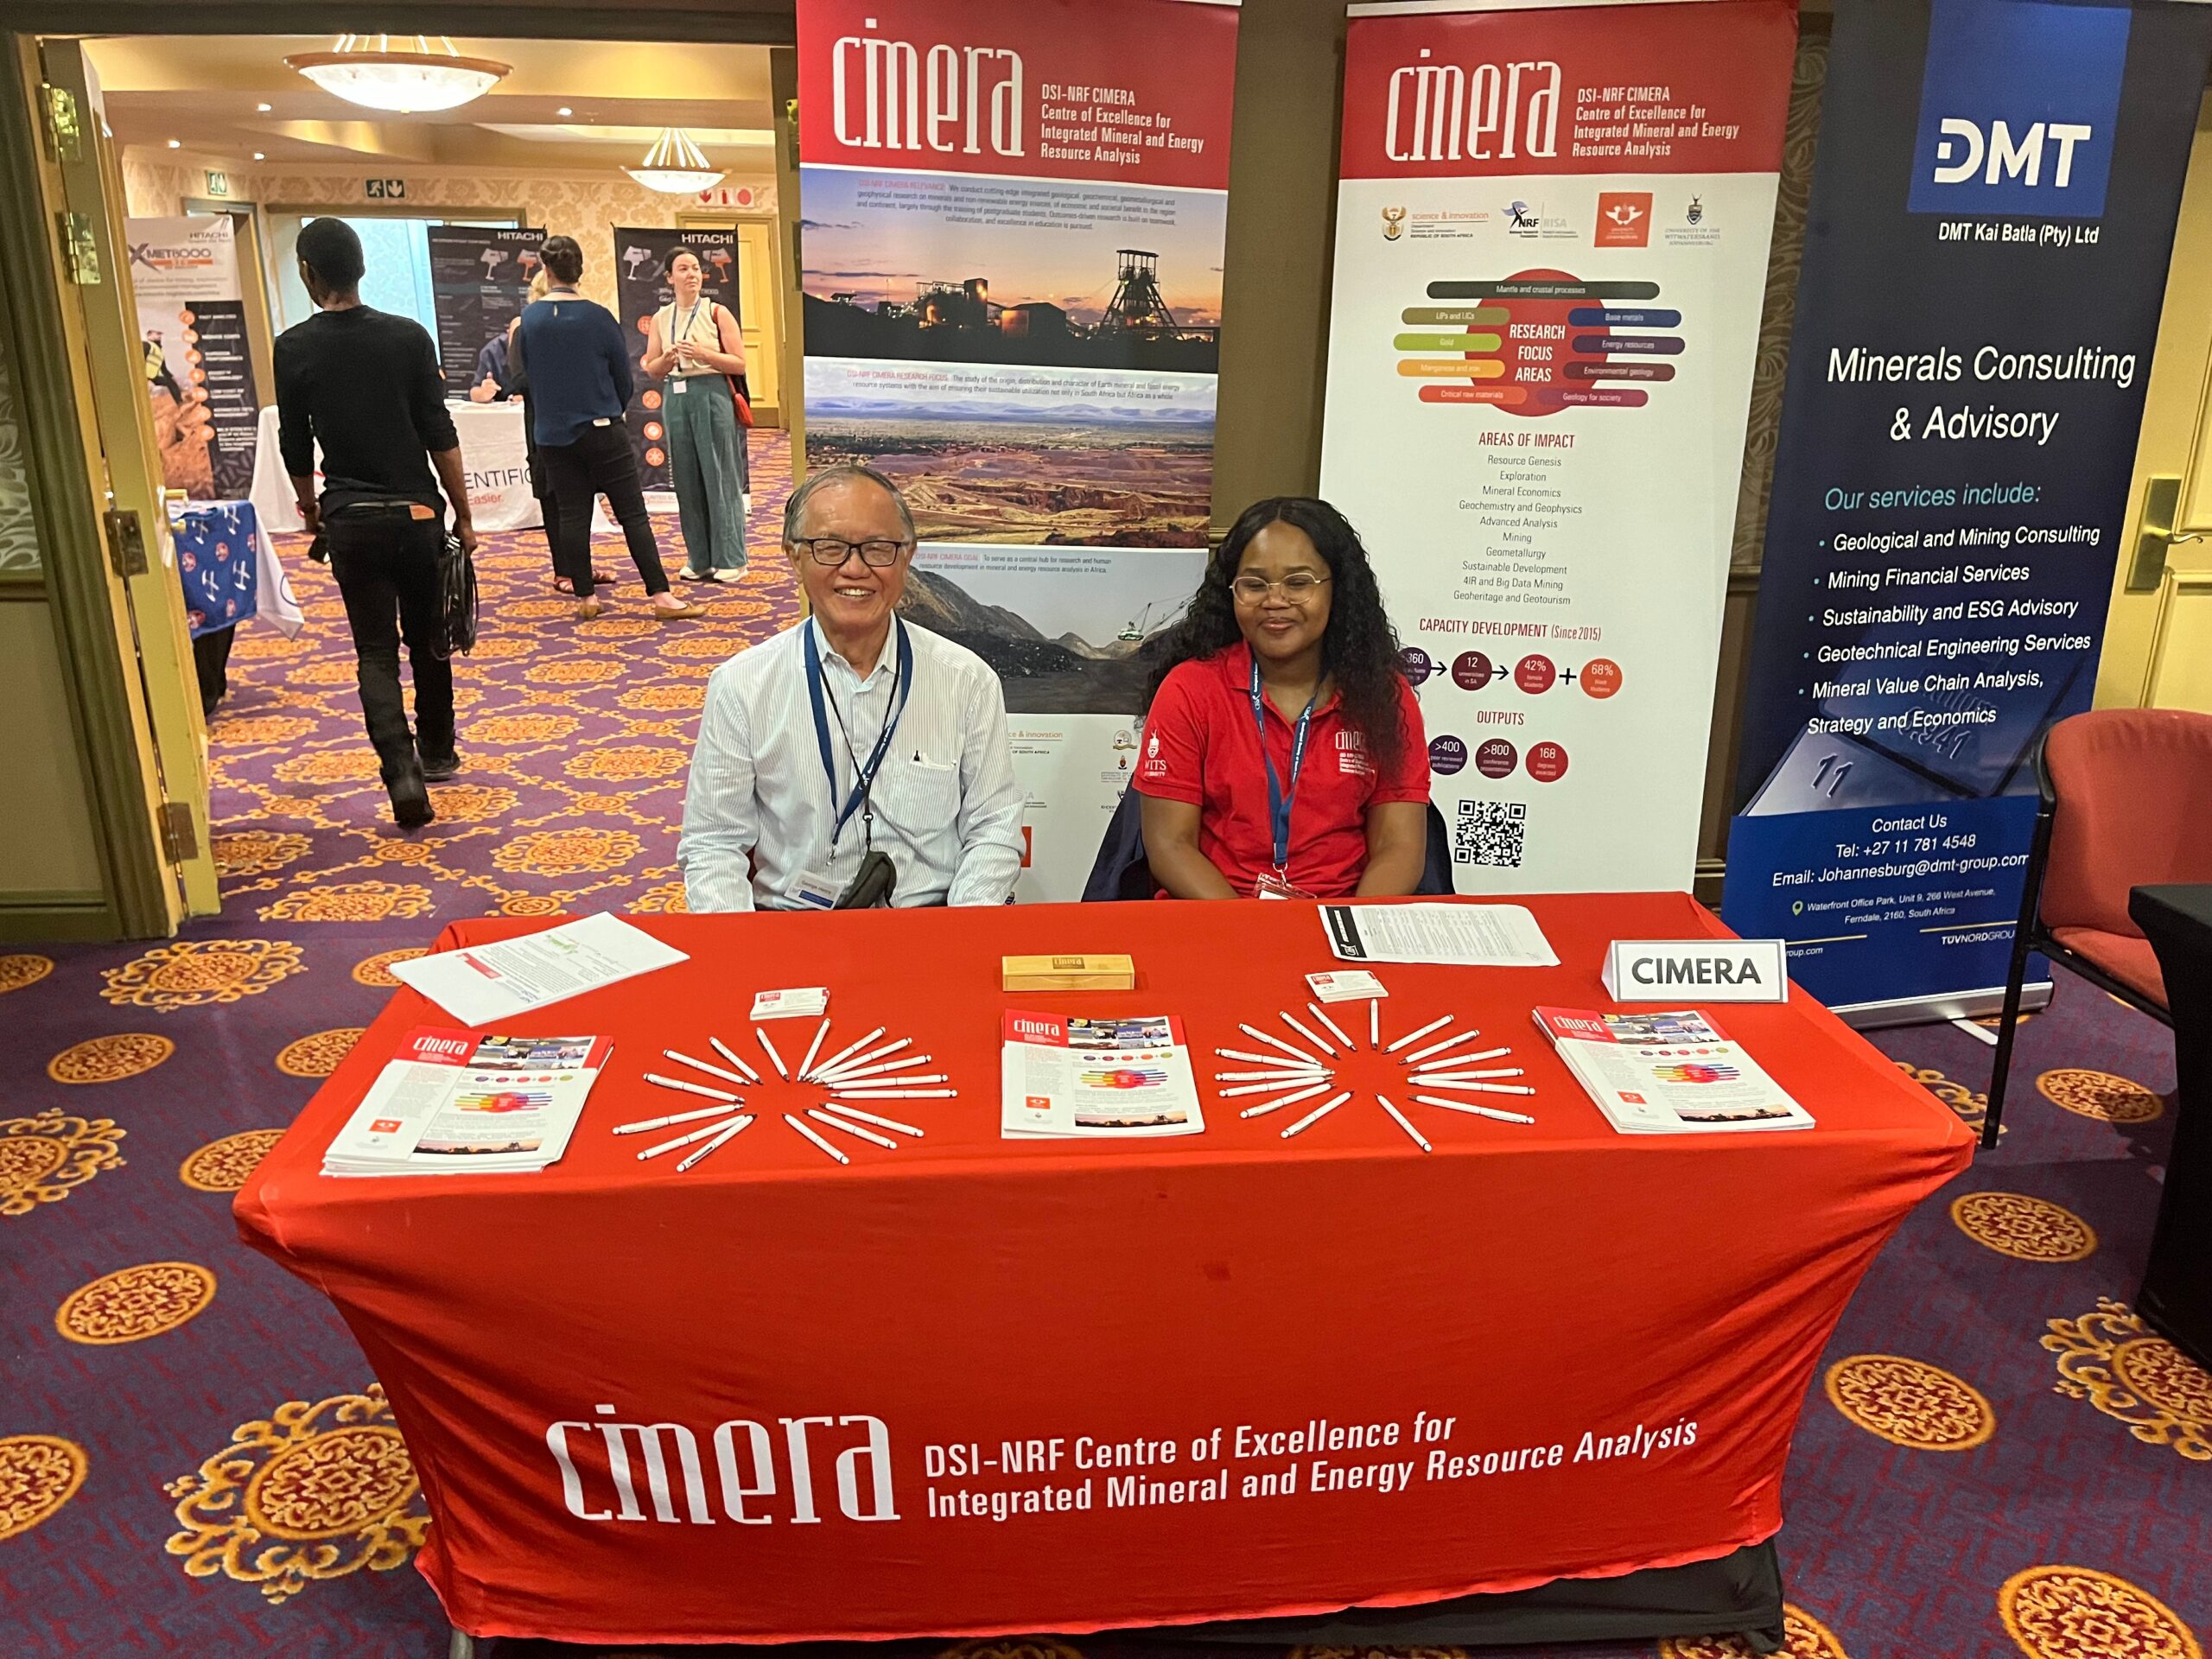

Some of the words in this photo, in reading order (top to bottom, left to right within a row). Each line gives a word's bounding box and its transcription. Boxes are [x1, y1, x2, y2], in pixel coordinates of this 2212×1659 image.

[832, 18, 1025, 156] cimera
[1042, 84, 1090, 102] DSI-NRF
[1092, 88, 1135, 105] CIMERA
[1578, 87, 1625, 103] DSI-NRF
[1627, 87, 1669, 101] CIMERA
[1385, 48, 1561, 161] cimera
[1041, 104, 1077, 120] Centre
[1081, 107, 1092, 122] of
[1096, 108, 1152, 127] Excellence
[1156, 112, 1171, 128] for
[1576, 107, 1610, 121] Centre
[1615, 106, 1625, 120] of
[1629, 105, 1686, 120] Excellence
[1690, 105, 1706, 118] for
[1041, 124, 1097, 143] Integrated
[1102, 127, 1141, 145] Mineral
[1146, 133, 1164, 147] and
[1168, 133, 1204, 153] Energy
[1573, 124, 1629, 141] Integrated
[1632, 124, 1675, 138] Mineral
[1678, 124, 1699, 137] and
[1702, 124, 1739, 139] Energy
[1041, 143, 1090, 160] Resource
[1094, 146, 1140, 166] Analysis
[1573, 143, 1621, 157] Resource
[1624, 142, 1671, 158] Analysis
[1934, 118, 2091, 188] DMT
[1519, 219, 1539, 227] NRF
[498, 232, 543, 241] HITACHI
[682, 233, 734, 244] HITACHI
[1939, 223, 1973, 240] DMT
[1974, 223, 1999, 241] Kai
[2002, 224, 2036, 242] Batla
[2039, 225, 2071, 247] (Pty)
[2075, 226, 2100, 244] Ltd
[1497, 285, 1518, 294] Mantle
[1510, 325, 1566, 340] RESEARCH
[1602, 340, 1622, 349] Energy
[1518, 346, 1553, 360] FOCUS
[1516, 368, 1551, 382] AREAS
[1584, 367, 1628, 376] Environmental
[1630, 368, 1654, 378] geology
[1827, 347, 1962, 382] Minerals
[1974, 346, 2135, 389] Consulting
[1563, 393, 1587, 402] Geology
[1599, 394, 1621, 403] society
[1891, 407, 1911, 441] &
[1923, 405, 2058, 445] Advisory
[1478, 432, 1514, 446] AREAS
[1517, 433, 1531, 447] OF
[1535, 434, 1575, 448] IMPACT
[1488, 455, 1526, 466] Resource
[1529, 456, 1561, 467] Genesis
[1500, 471, 1546, 481] Exploration
[1483, 486, 1515, 496] Mineral
[1517, 487, 1561, 497] Economics
[1825, 487, 1864, 510] Our
[1869, 485, 1955, 509] services
[1963, 481, 2041, 505] include:
[1459, 500, 1515, 512] Geochemistry
[1517, 503, 1533, 512] and
[1535, 504, 1582, 514] Geophysics
[1480, 517, 1520, 527] Advanced
[1522, 518, 1557, 529] Analysis
[1503, 533, 1532, 543] Mining
[1834, 531, 1919, 553] Geological
[1923, 530, 1955, 548] and
[1960, 528, 2011, 548] Mining
[2015, 525, 2101, 546] Consulting
[1486, 547, 1546, 559] Geometallurgy
[1462, 562, 1510, 572] Sustainable
[1513, 563, 1567, 575] Development
[1464, 576, 1477, 585] 4IR
[1497, 579, 1510, 588] Big
[1512, 579, 1531, 588] Data
[1535, 580, 1563, 591] Mining
[1828, 571, 1879, 591] Mining
[1885, 567, 1958, 587] Financial
[1962, 563, 2030, 582] Services
[1454, 591, 1503, 602] Geoheritage
[1505, 594, 1521, 602] and
[1523, 594, 1571, 605] Geotourism
[1822, 605, 1929, 626] Sustainability
[1933, 603, 1963, 620] and
[1967, 601, 2004, 618] ESG
[2007, 599, 2078, 619] Advisory
[1420, 619, 1469, 633] CAPACITY
[1472, 621, 1548, 638] DEVELOPMENT
[1551, 624, 1577, 639] (Since
[1578, 626, 1601, 641] 2015)
[1817, 641, 1922, 663] Geotechnical
[1927, 637, 2019, 659] Engineering
[2024, 633, 2091, 652] Services
[1467, 657, 1478, 668] 12
[1524, 660, 1547, 672] 42%
[1592, 664, 1613, 676] 68%
[1813, 679, 1870, 699] Mineral
[1876, 677, 1919, 695] Value
[1924, 674, 1969, 692] Chain
[1974, 671, 2044, 690] Analysis,
[1478, 710, 1524, 726] OUTPUTS
[1808, 714, 1873, 734] Strategy
[1877, 711, 1907, 730] and
[1912, 709, 1997, 728] Economics
[1434, 741, 1459, 753] >400
[1484, 745, 1509, 756] >800
[1540, 747, 1555, 759] 168
[1872, 817, 1925, 833] Contact
[1929, 815, 1948, 830] Us
[1836, 843, 1859, 858] Tel:
[1863, 842, 1890, 856] +27
[1894, 840, 1908, 854] 11
[1914, 838, 1937, 852] 781
[1942, 834, 1976, 850] 4548
[1772, 870, 1815, 887] Email:
[1808, 900, 1849, 912] Waterfront
[1851, 898, 1874, 909] Office
[1899, 894, 1916, 904] Unit
[1943, 890, 1963, 899] West
[1909, 908, 1932, 919] South
[1934, 906, 1955, 916] Africa
[1631, 957, 1762, 984] CIMERA
[1014, 1018, 1060, 1036] cimera
[1554, 1015, 1603, 1033] cimera
[413, 1036, 469, 1055] cimera
[925, 1440, 1065, 1479] DSI-NRF
[1074, 1434, 1177, 1470] Centre
[1192, 1427, 1223, 1462] of
[1234, 1418, 1400, 1459] Excellence
[1414, 1411, 1456, 1443] for
[545, 1404, 901, 1525] cimera
[927, 1478, 1093, 1522] Integrated
[1107, 1469, 1229, 1509] Mineral
[1242, 1463, 1296, 1498] and
[1311, 1457, 1414, 1494] Energy
[1427, 1444, 1563, 1482] Resource
[1573, 1417, 1698, 1464] Analysis
